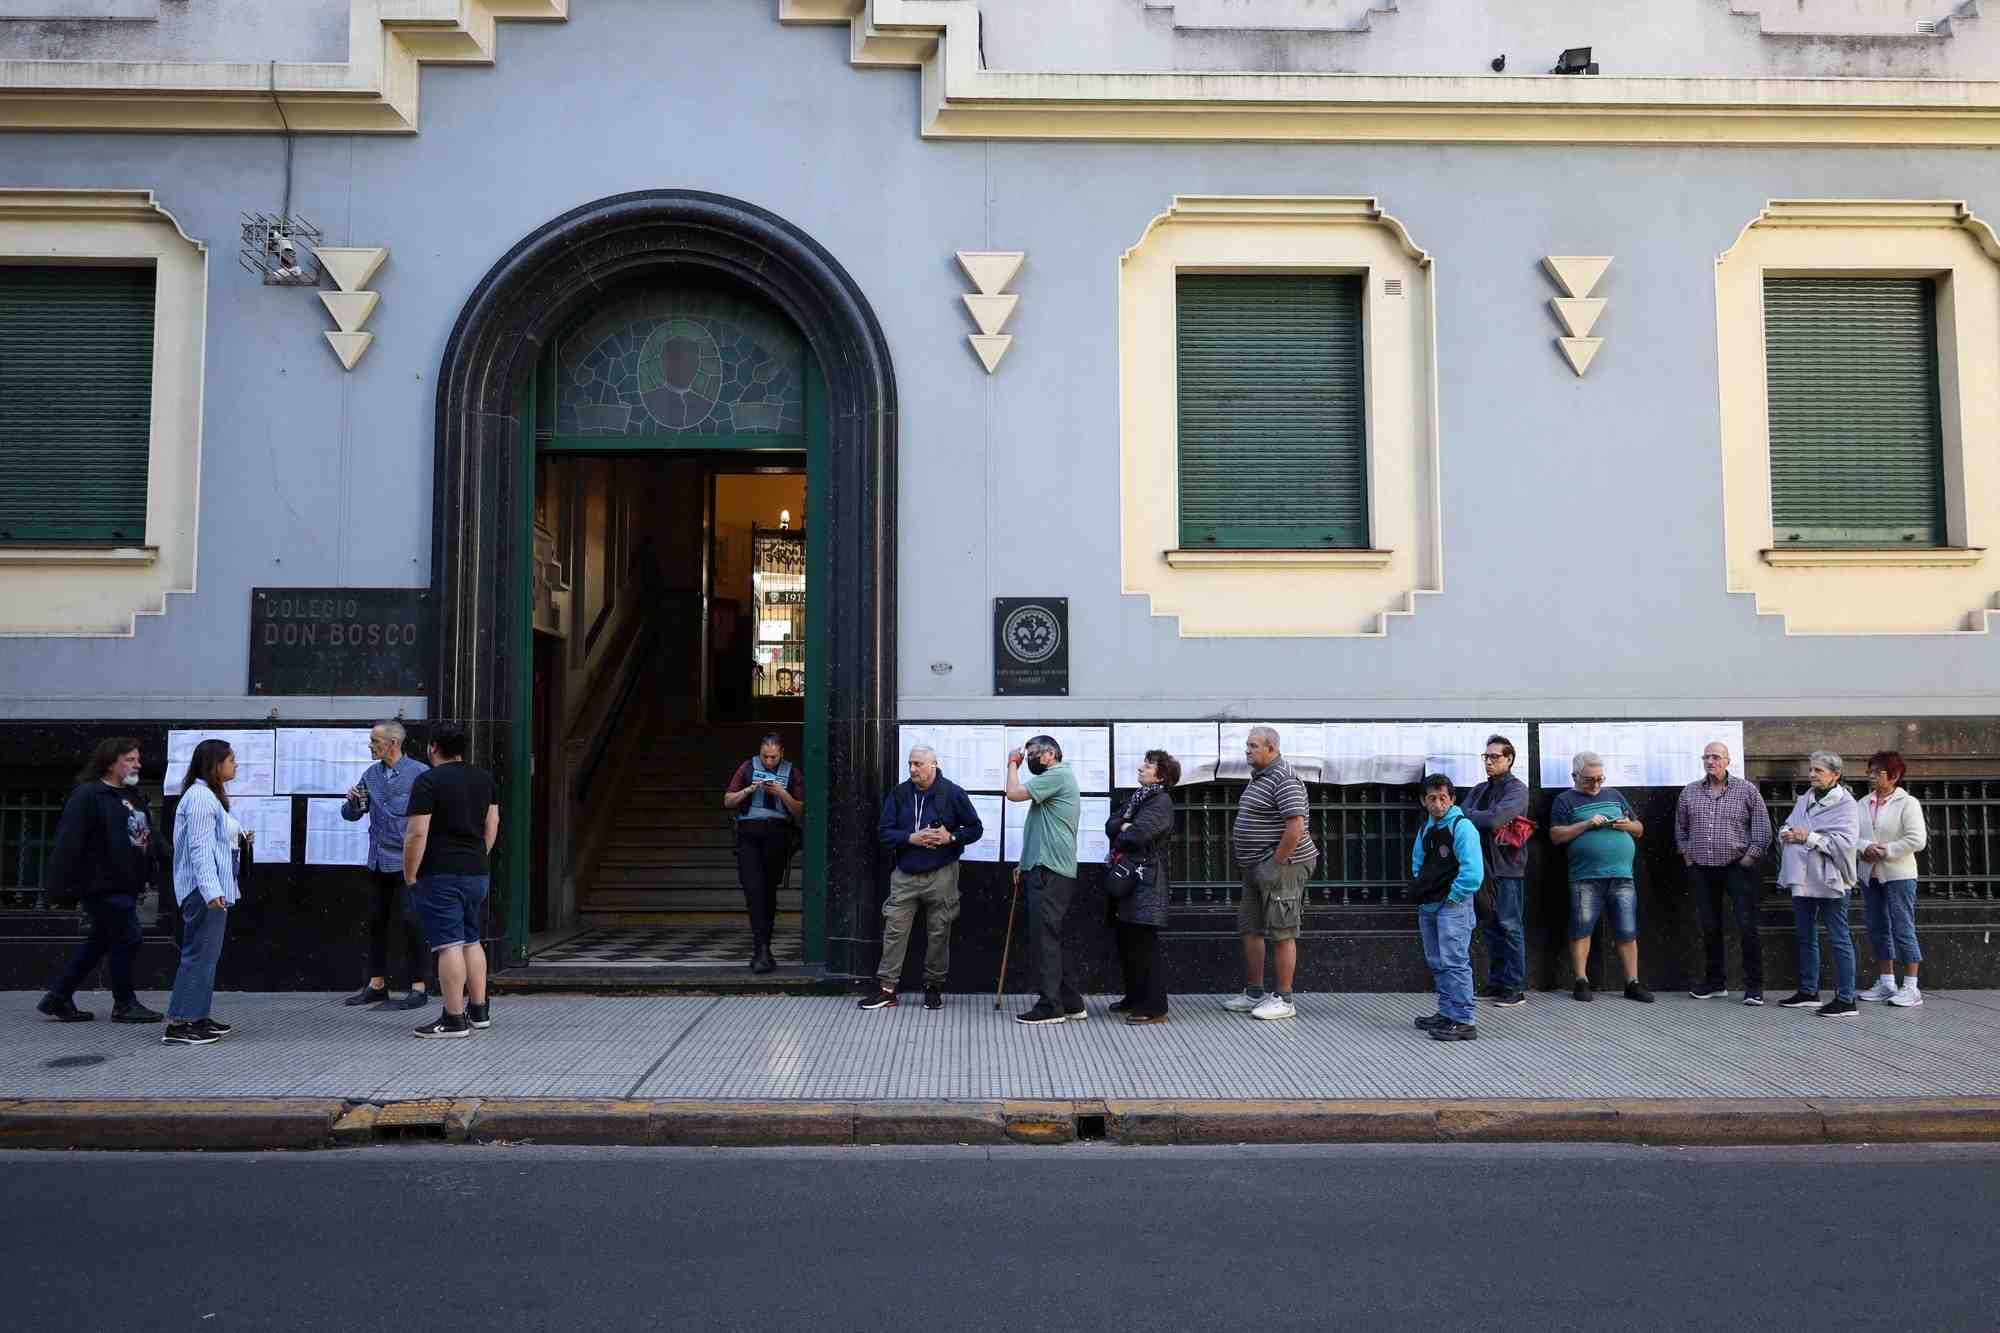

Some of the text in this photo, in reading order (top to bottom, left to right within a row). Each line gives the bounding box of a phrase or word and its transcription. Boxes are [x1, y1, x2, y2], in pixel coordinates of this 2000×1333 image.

[265, 599, 358, 618] COLEGIO
[264, 623, 417, 646] DON BOSCO
